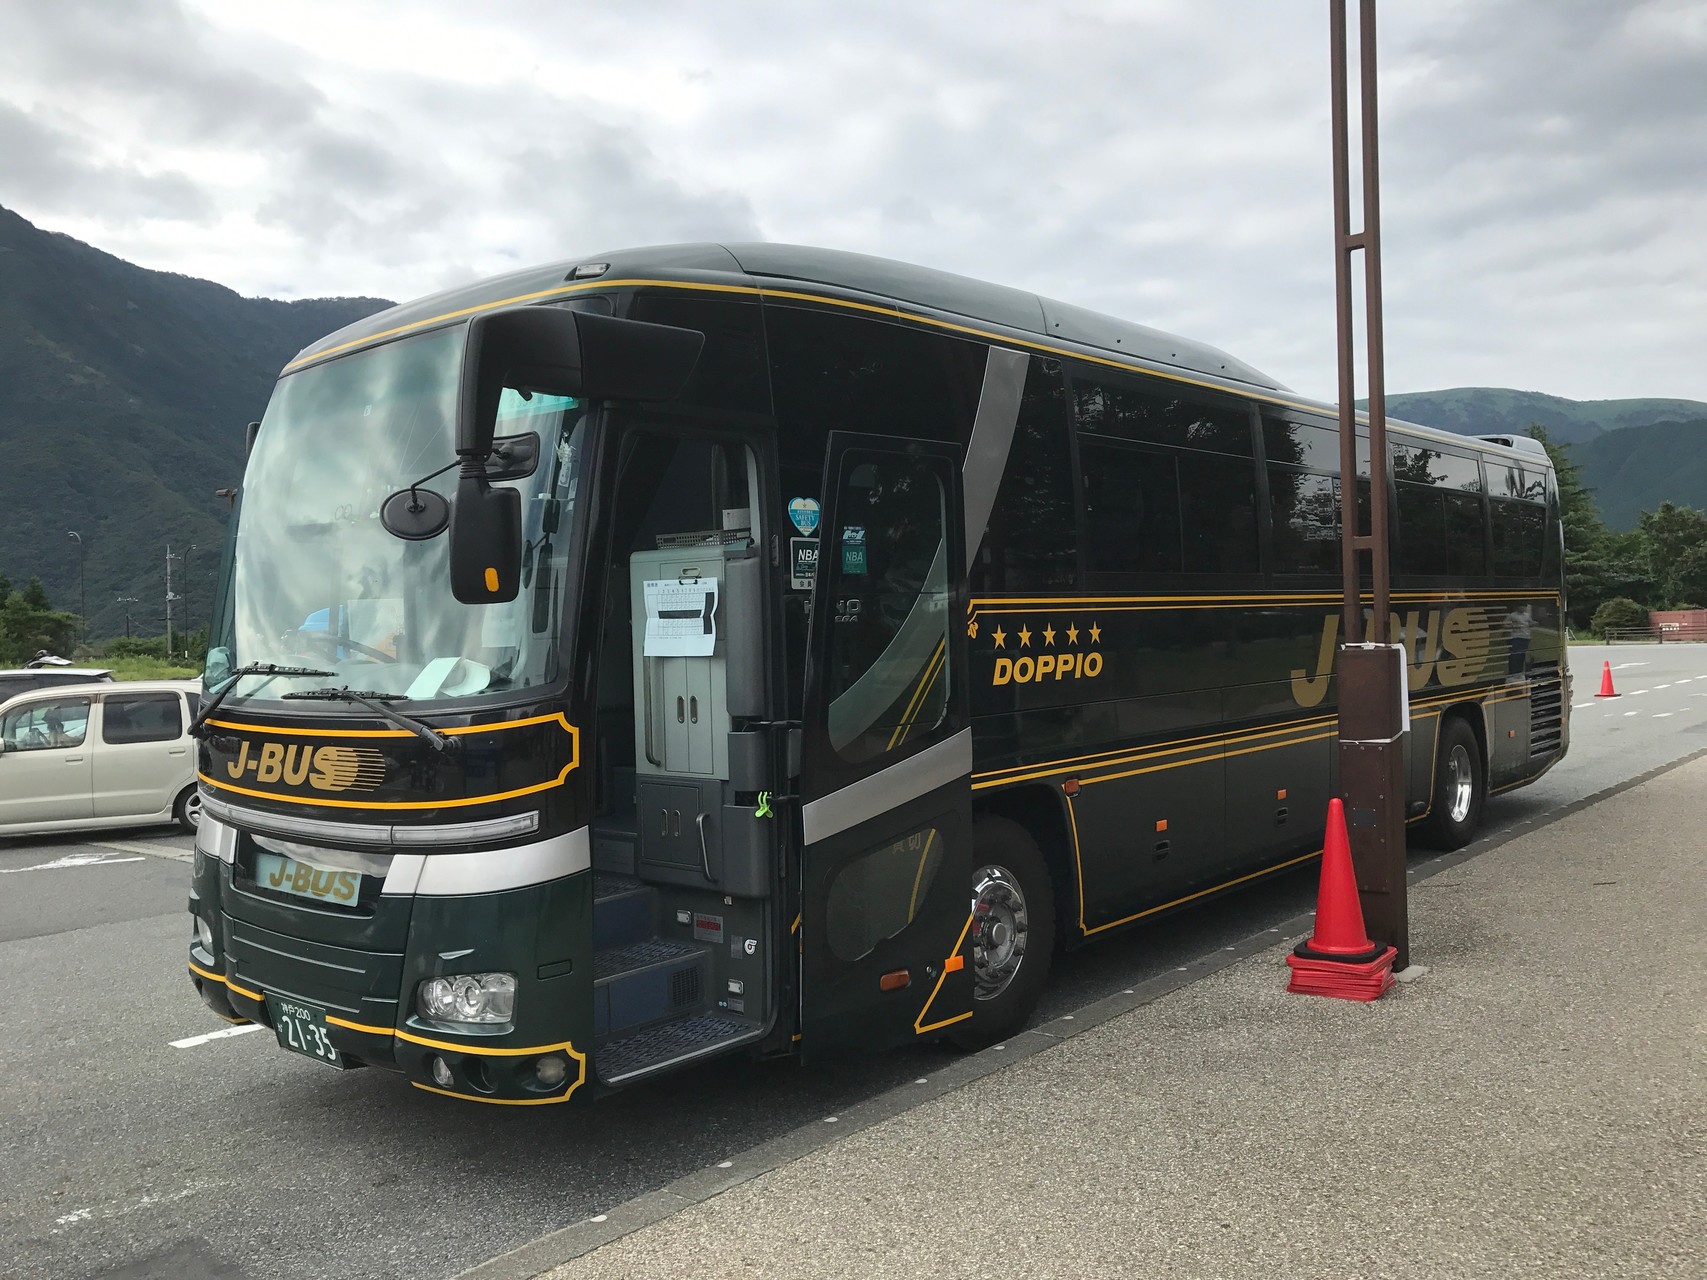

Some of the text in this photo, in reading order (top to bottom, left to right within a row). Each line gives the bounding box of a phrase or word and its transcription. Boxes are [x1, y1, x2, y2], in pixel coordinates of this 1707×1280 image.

[798, 549, 818, 561] NBA
[846, 551, 863, 562] NBA
[992, 652, 1103, 686] DOPPIO
[1291, 607, 1512, 708] JUS
[227, 741, 386, 792] J-BUS
[269, 858, 358, 901] J-BUS
[281, 1015, 336, 1060] 21-35
